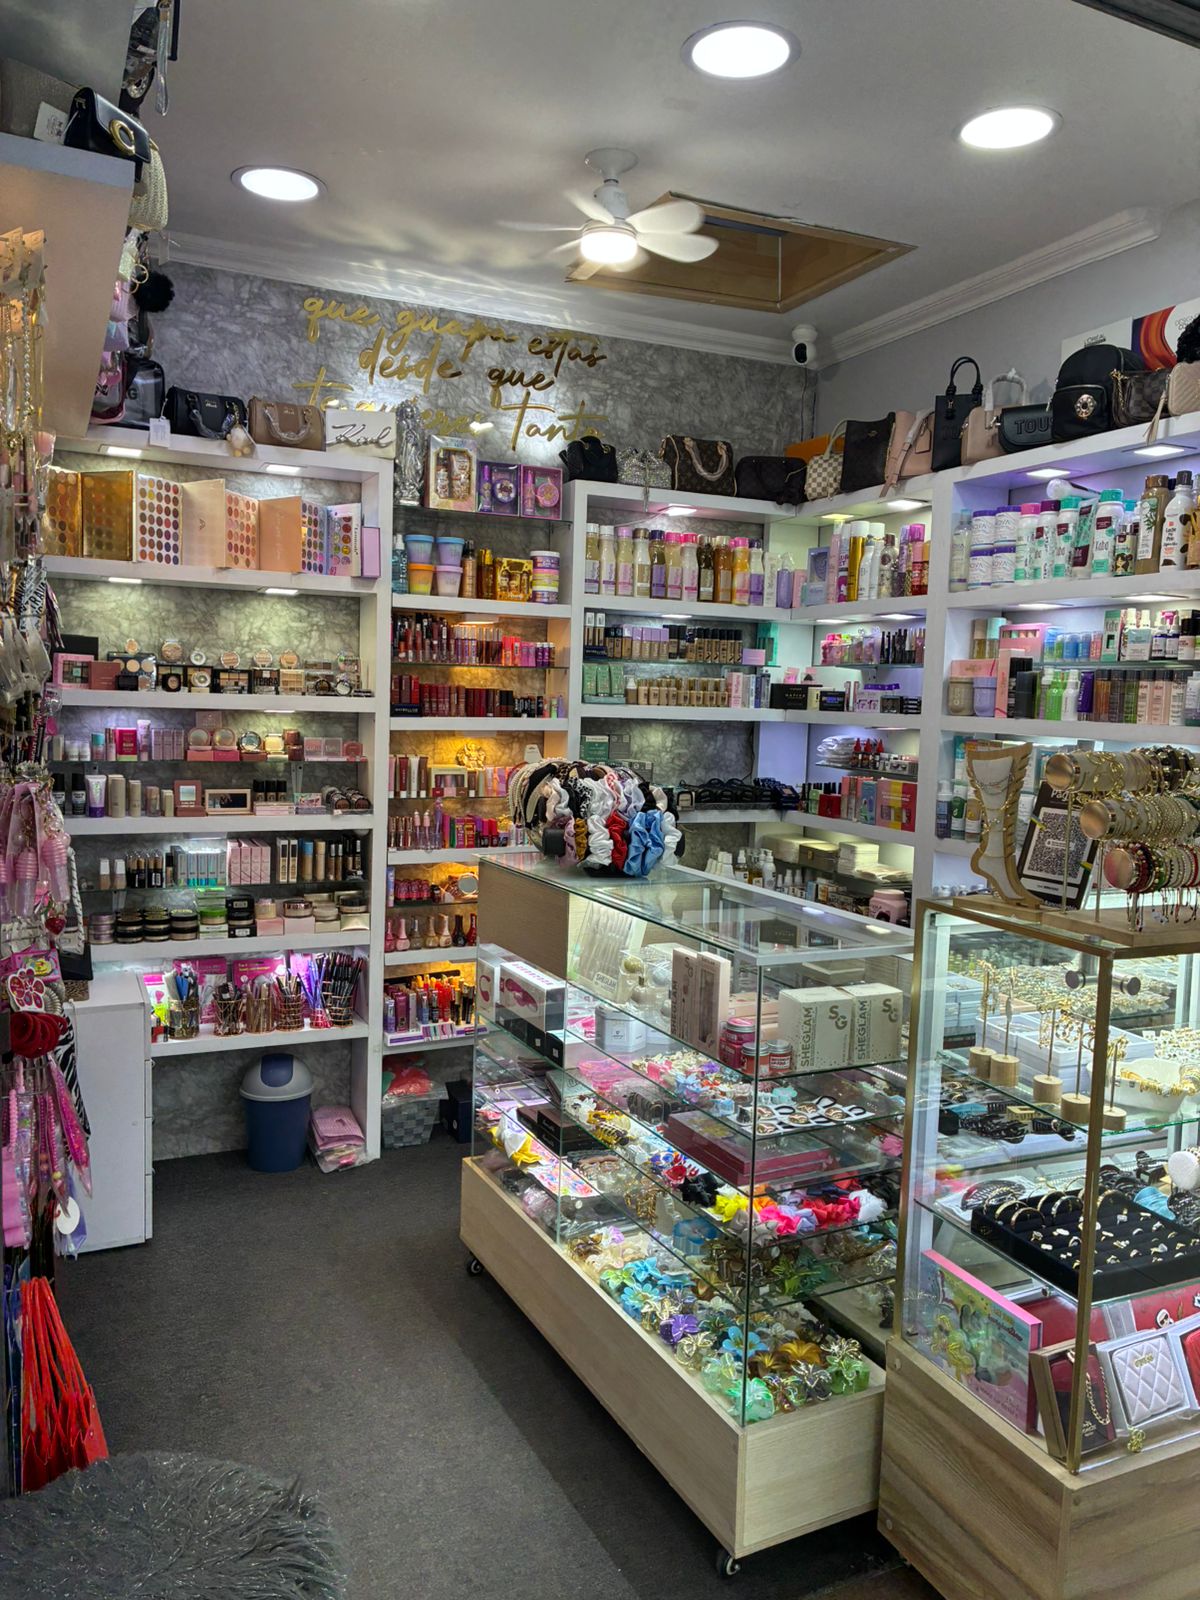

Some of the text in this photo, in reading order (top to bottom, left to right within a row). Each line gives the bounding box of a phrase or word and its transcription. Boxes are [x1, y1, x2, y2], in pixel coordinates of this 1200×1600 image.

[303, 296, 381, 344] que
[387, 308, 519, 363] guapa
[358, 326, 555, 410] desde que
[1014, 415, 1054, 435] TOU
[800, 1007, 814, 1067] SHEGLAM
[858, 1000, 868, 1061] SHEGLAM
